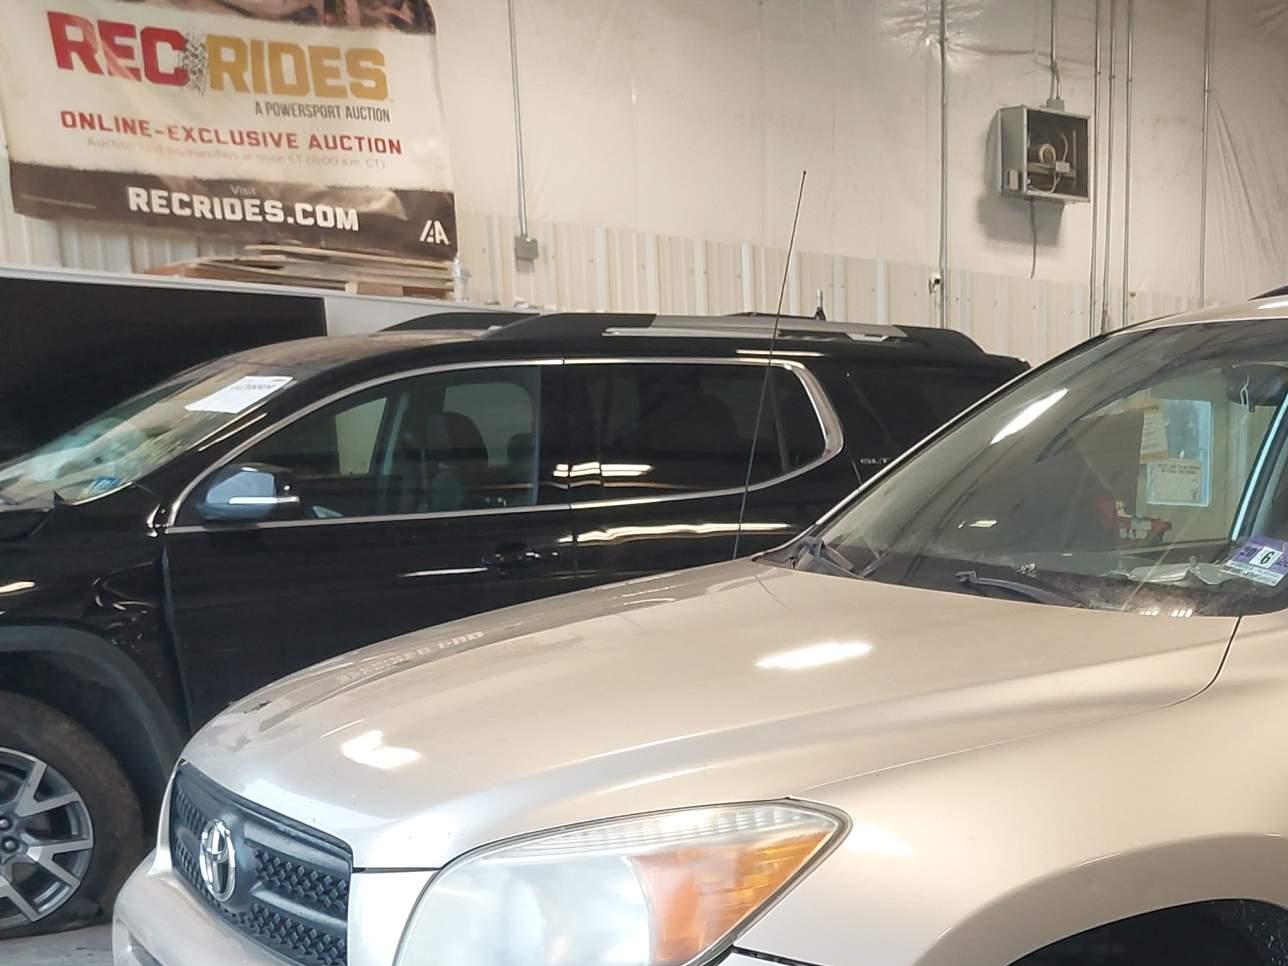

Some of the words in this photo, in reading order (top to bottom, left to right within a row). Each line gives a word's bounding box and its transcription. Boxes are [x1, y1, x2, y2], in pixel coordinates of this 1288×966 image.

[47, 11, 190, 87] REC
[206, 34, 389, 102] RIDES
[255, 102, 263, 116] A
[265, 102, 342, 119] POWERSPORT
[345, 106, 391, 123] AUCTION
[60, 110, 299, 149] ONLINE-EXCLUSIVE
[308, 133, 403, 155] AUCTION
[230, 184, 256, 196] Visit
[128, 186, 360, 232] RECRIDES.COM
[1260, 550, 1275, 565] 6
